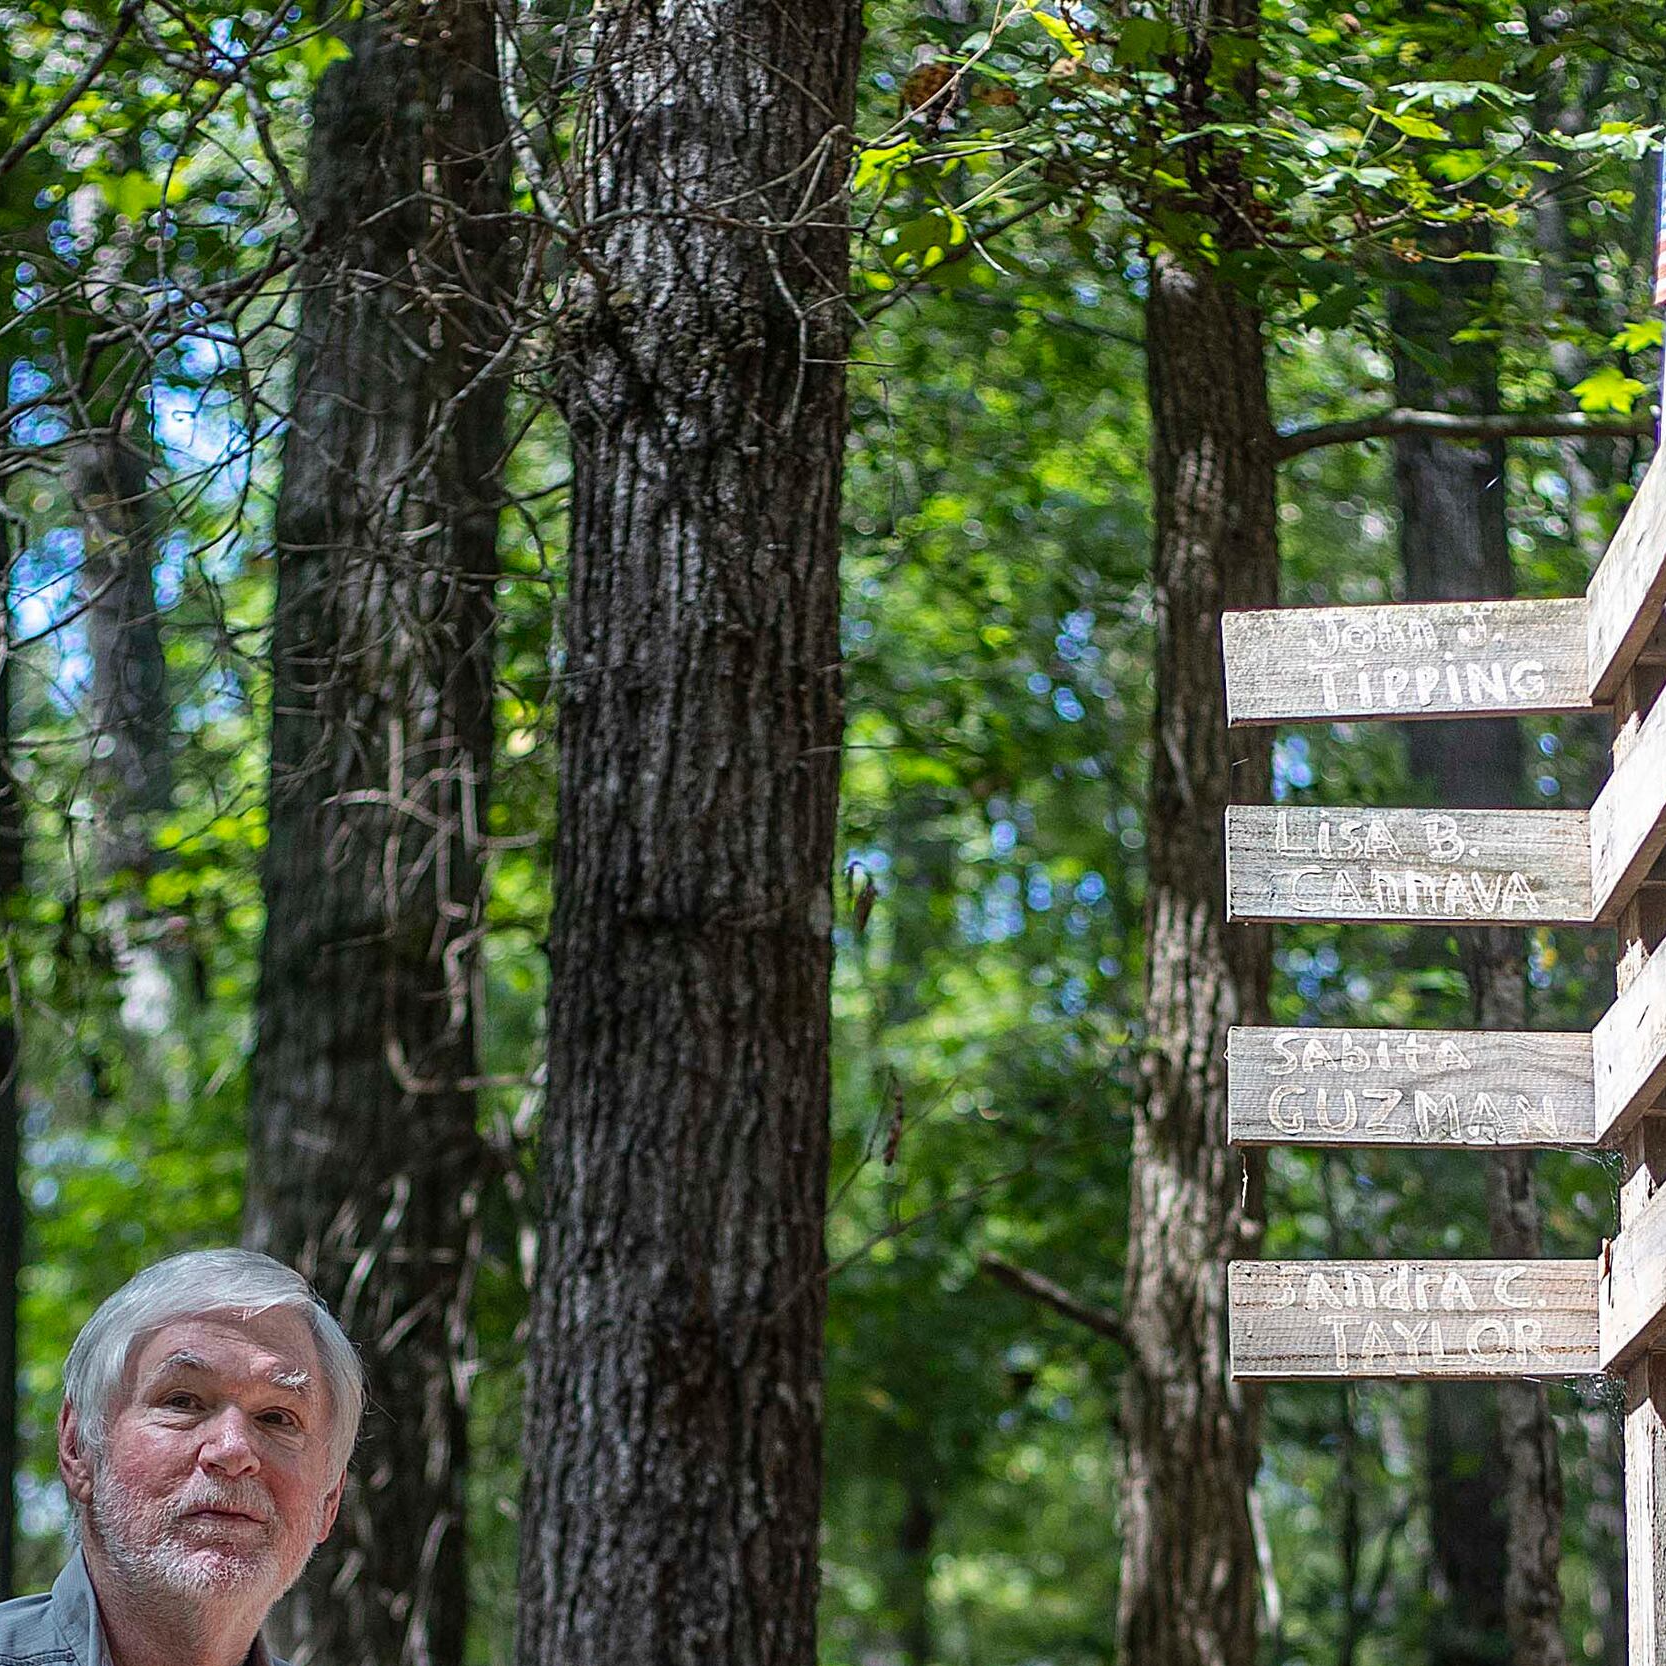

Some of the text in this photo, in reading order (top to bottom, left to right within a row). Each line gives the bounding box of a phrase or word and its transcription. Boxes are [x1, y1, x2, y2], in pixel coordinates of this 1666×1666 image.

[1422, 814, 1479, 863] B.
[1268, 1085, 1559, 1138] GUZMAN
[1494, 1266, 1547, 1308] C.
[1319, 1316, 1555, 1369] TAYLOR
